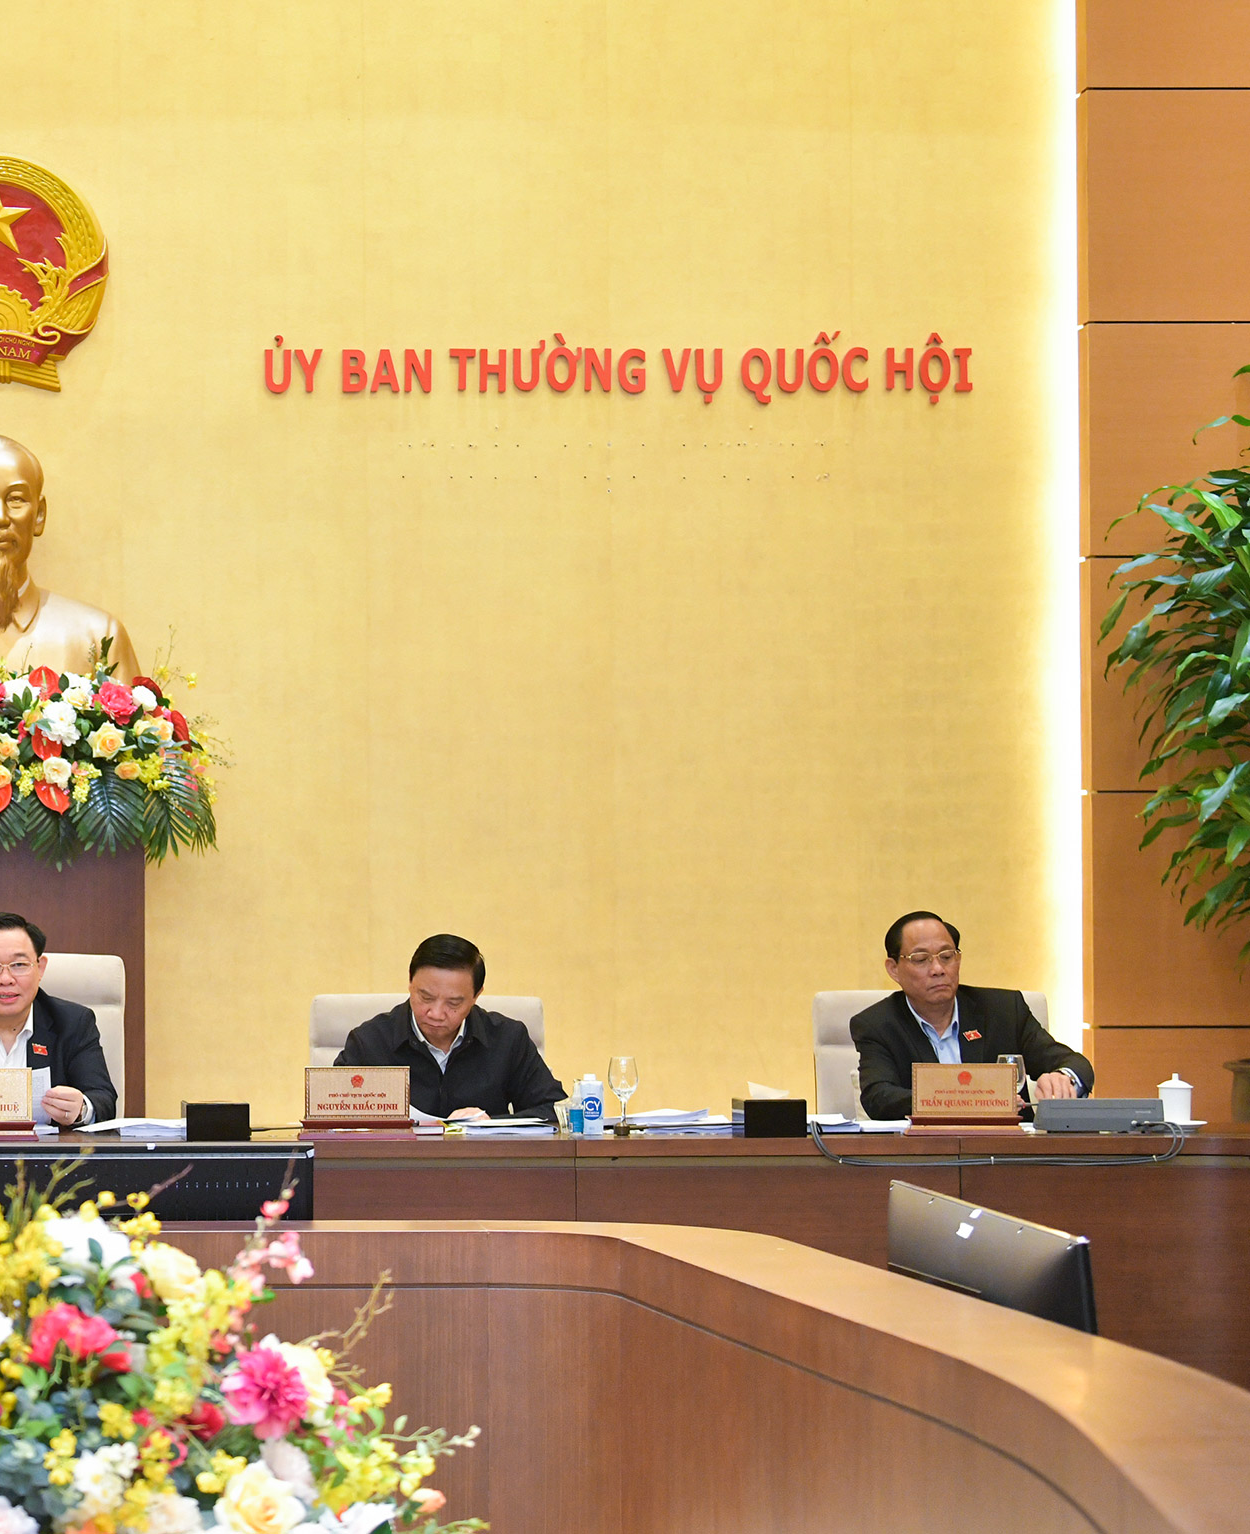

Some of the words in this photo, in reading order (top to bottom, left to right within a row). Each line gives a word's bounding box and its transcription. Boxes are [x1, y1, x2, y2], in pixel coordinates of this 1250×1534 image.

[264, 335, 323, 394] ỦY
[342, 348, 432, 393] BAN
[450, 333, 646, 393] THƯỜNG
[662, 348, 723, 403] VỤ
[740, 331, 869, 404] QUỐC
[886, 333, 973, 404] HỘI
[0, 1101, 20, 1113] HUỆ
[584, 1100, 600, 1111] ICY
[944, 1099, 973, 1108] QUANG
